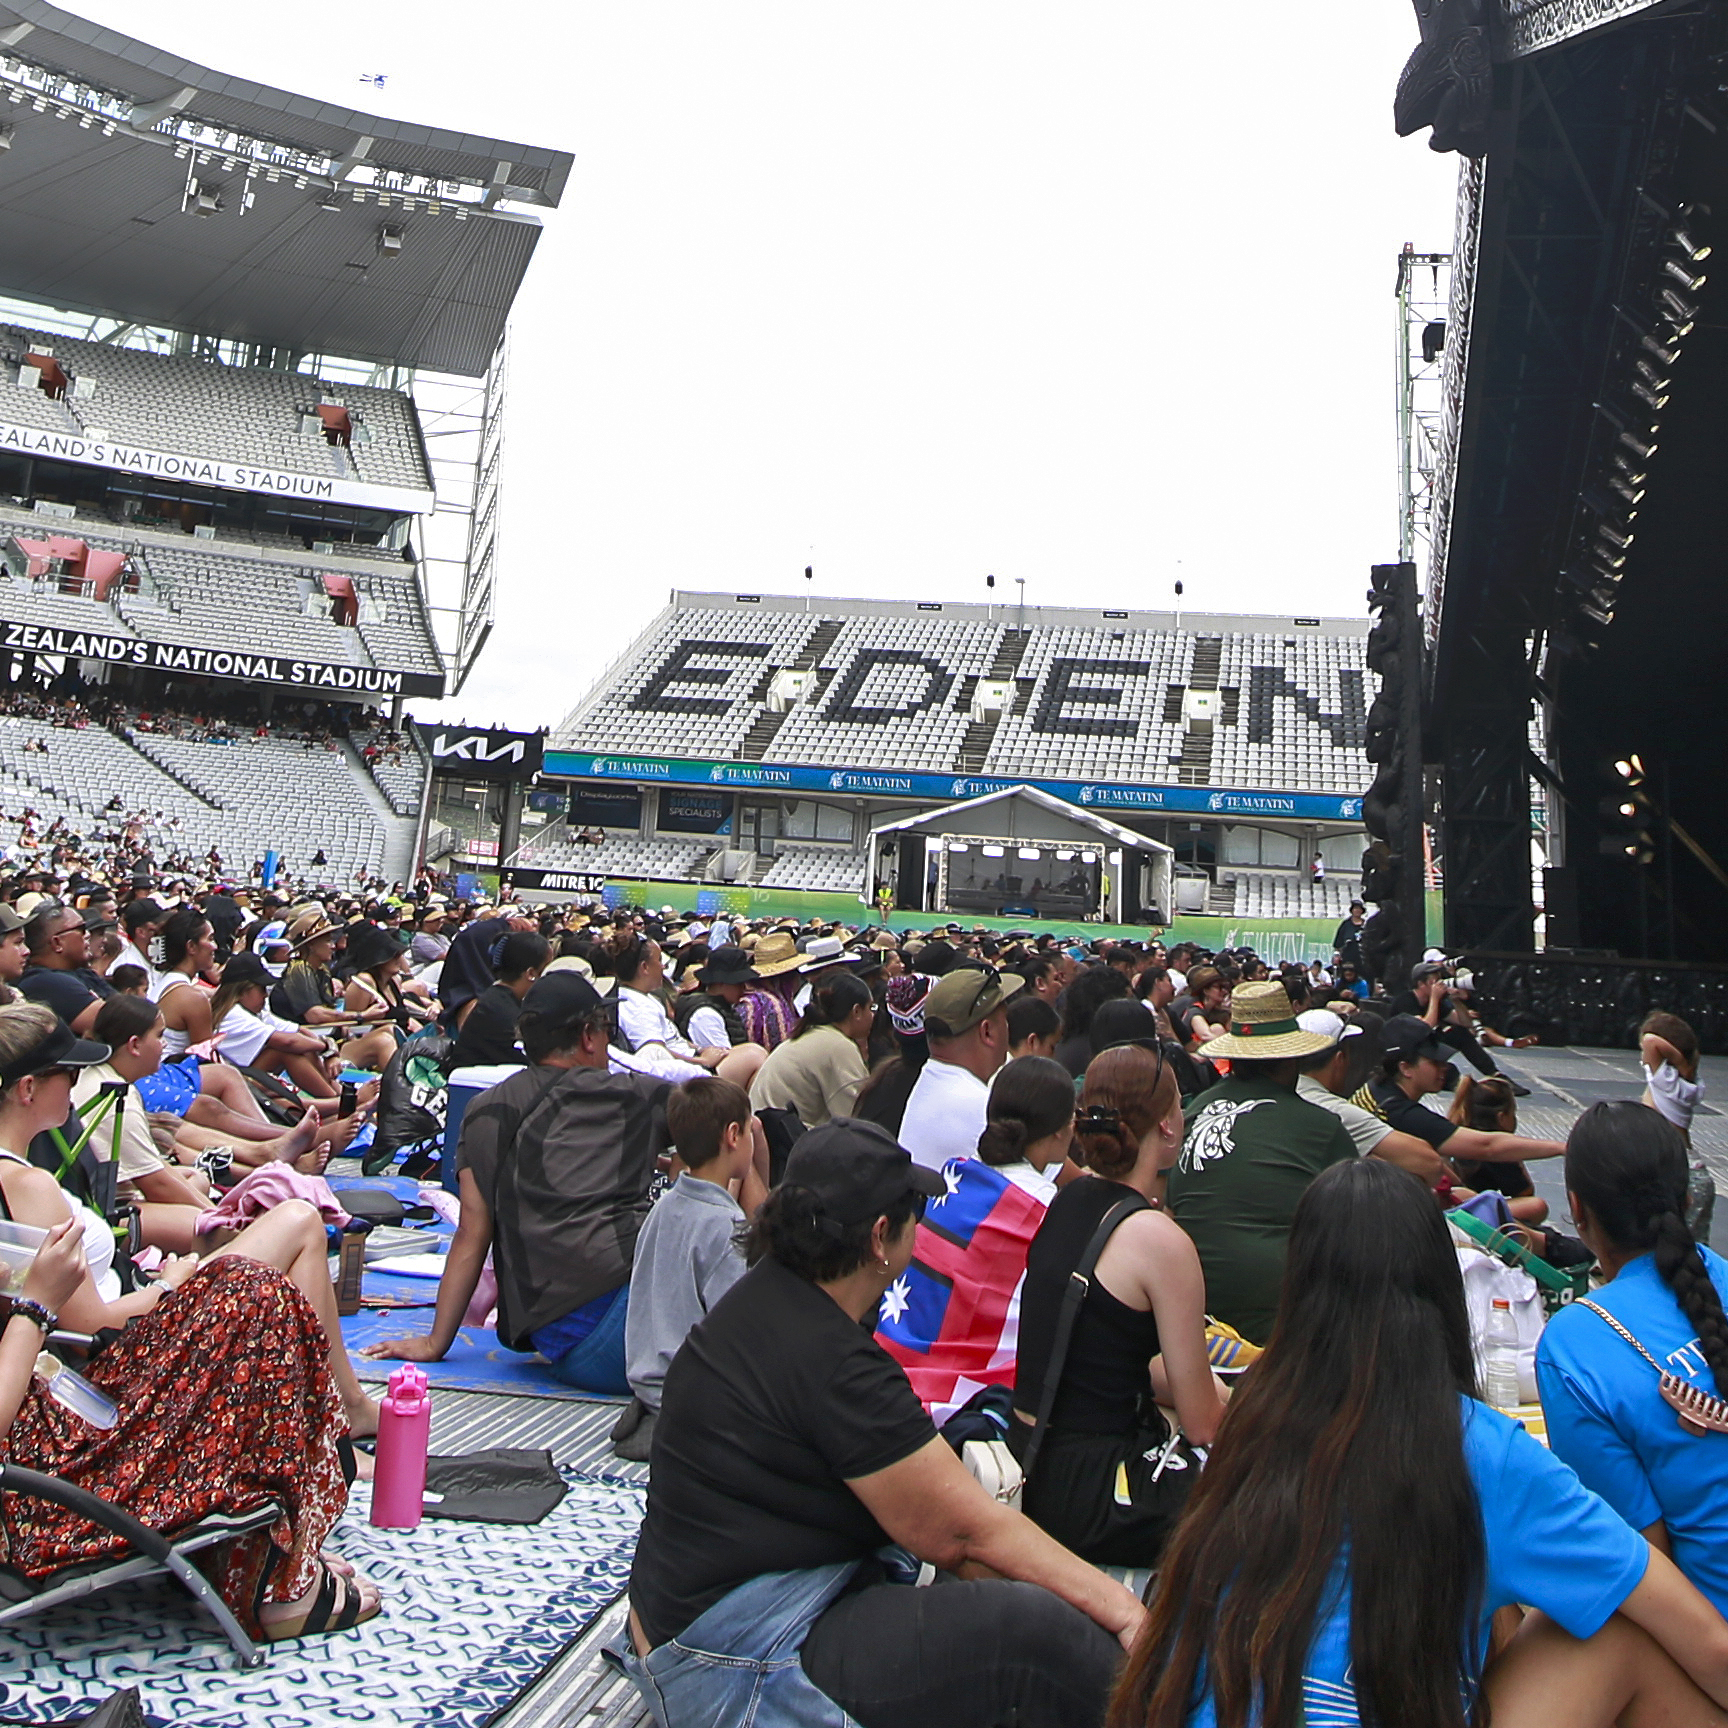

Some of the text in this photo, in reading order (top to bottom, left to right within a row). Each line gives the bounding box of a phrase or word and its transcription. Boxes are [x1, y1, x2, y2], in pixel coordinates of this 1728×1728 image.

[112, 446, 227, 483] NATIONAL
[234, 467, 334, 497] STADIUM
[4, 622, 149, 664] ZEALAND'S
[154, 644, 285, 681] NATIONAL
[289, 661, 403, 692] STADIUM
[626, 638, 1367, 750] EDEN
[607, 760, 670, 774] TE MATATINI
[727, 767, 741, 779] TE
[743, 768, 791, 782] MATATINI
[846, 774, 861, 786] TE
[862, 776, 912, 790] MATATINI
[1095, 788, 1111, 801] TE
[1113, 789, 1164, 803] MATATINI
[1225, 795, 1241, 808] TE
[1242, 797, 1295, 810] MATATINI
[668, 806, 722, 819] SPECIALISTS
[540, 873, 604, 891] MITRE 10
